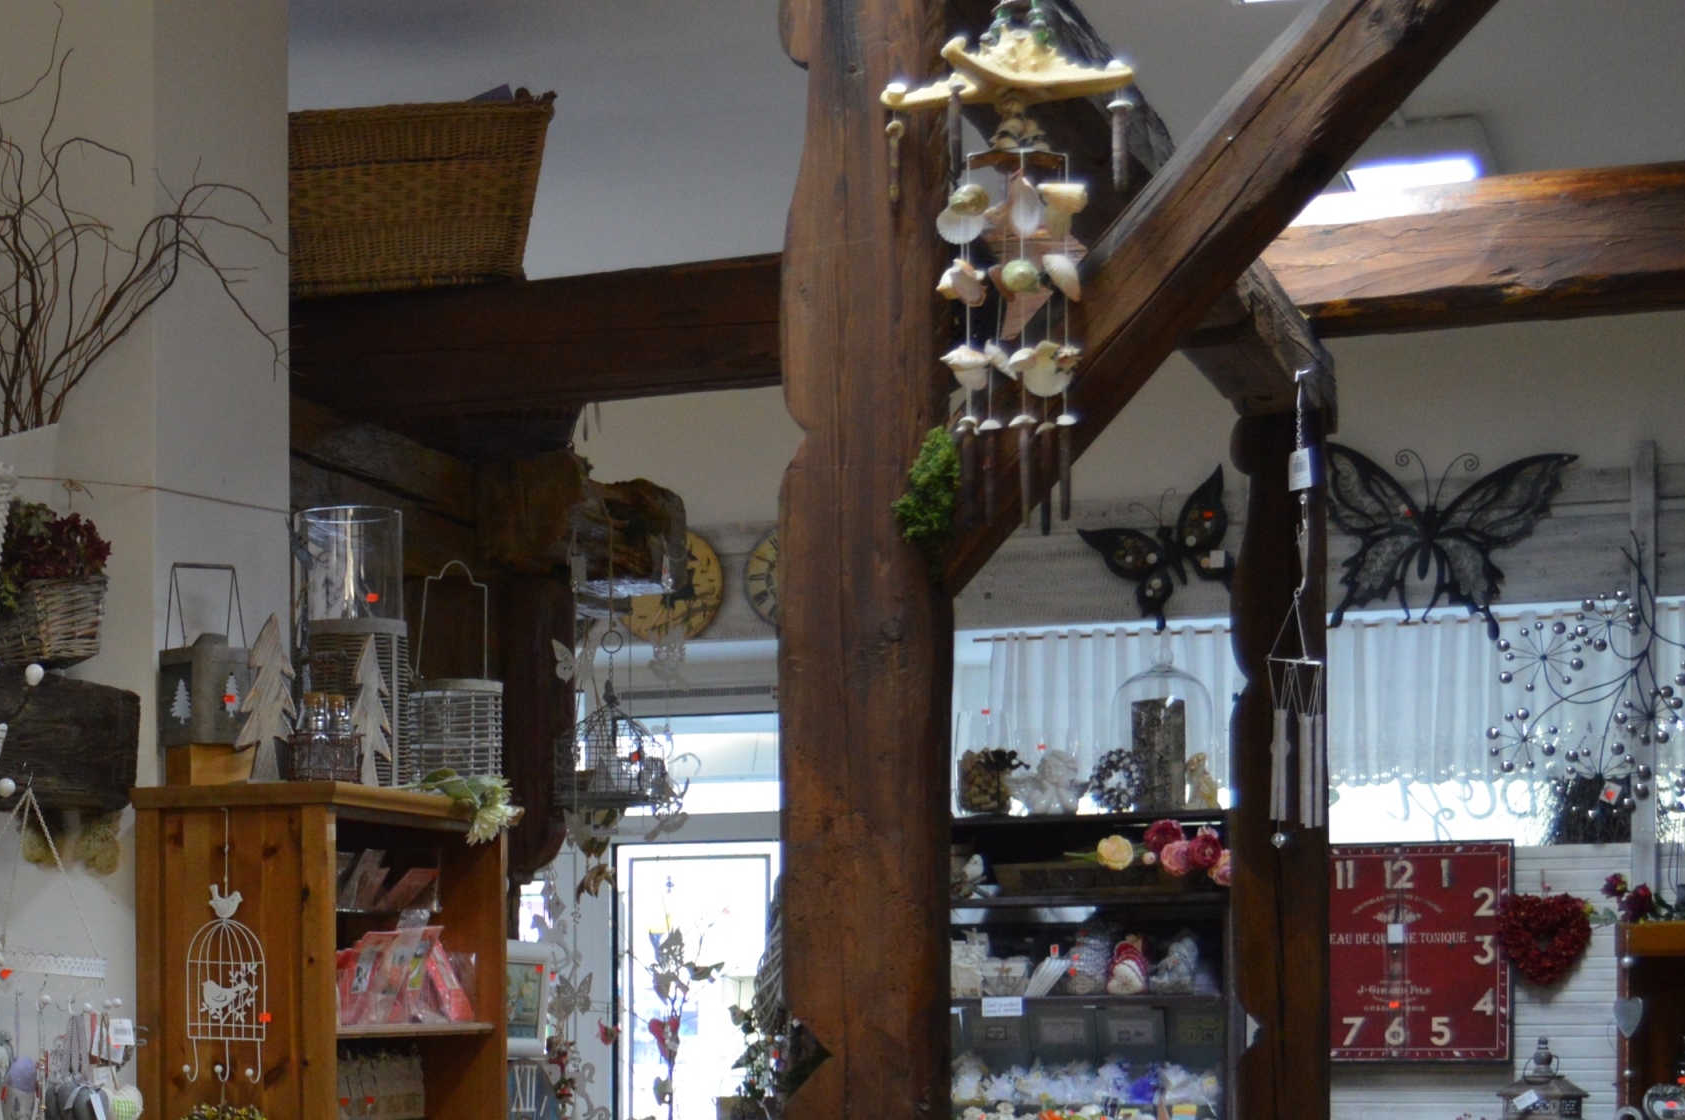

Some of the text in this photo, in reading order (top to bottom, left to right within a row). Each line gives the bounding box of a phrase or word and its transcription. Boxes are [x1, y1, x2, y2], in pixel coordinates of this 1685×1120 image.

[1335, 858, 1451, 890] 11 12 1
[1473, 887, 1496, 917] 2
[1356, 933, 1369, 945] DE
[1372, 932, 1418, 945] QUNE
[1420, 931, 1468, 944] TONIQUE
[1473, 935, 1496, 965] 3
[1472, 988, 1494, 1016] 4
[1342, 1017, 1451, 1046] 7 6 5
